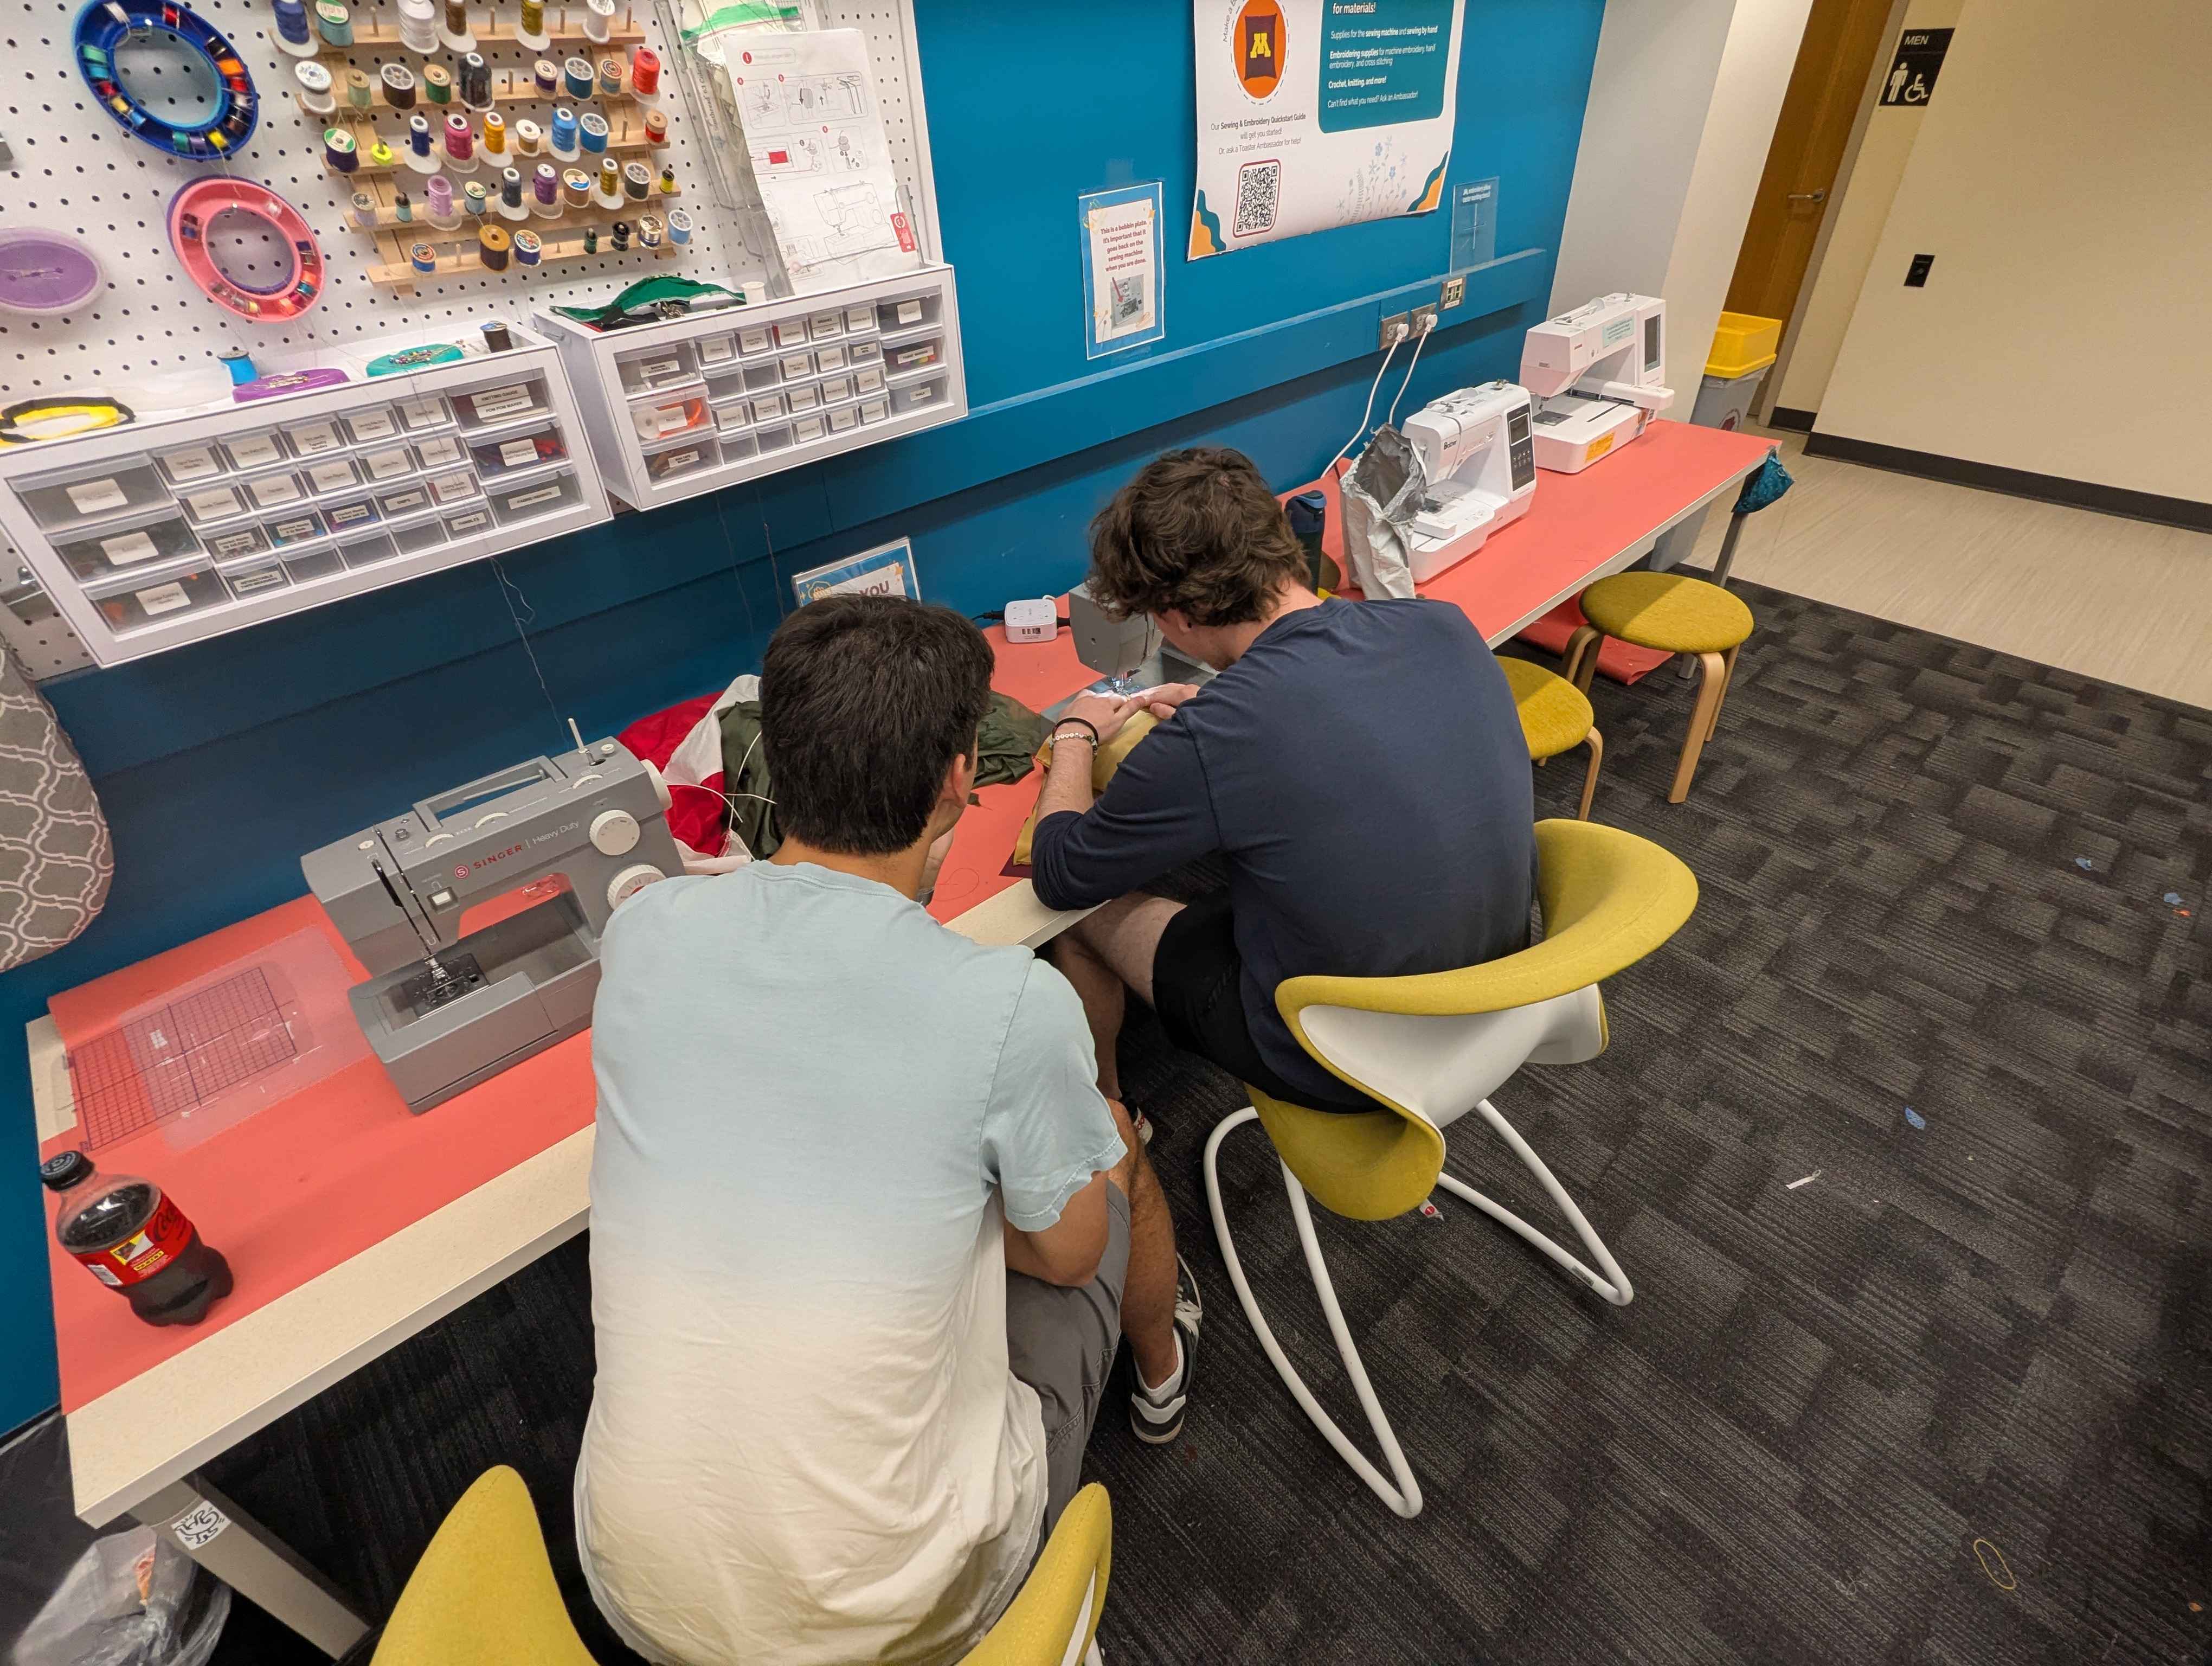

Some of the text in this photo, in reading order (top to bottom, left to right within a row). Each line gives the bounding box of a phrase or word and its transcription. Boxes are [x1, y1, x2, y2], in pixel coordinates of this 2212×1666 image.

[1333, 2, 1377, 14] for materials!
[1331, 31, 1350, 40] Supplies
[1366, 29, 1380, 38] sewing
[1381, 28, 1398, 36] machine
[1407, 27, 1421, 36] sewing
[1422, 26, 1427, 35] by
[1904, 35, 1929, 46] MEN
[1330, 49, 1360, 59] Embroidering
[1361, 48, 1379, 58] supplies
[1376, 57, 1393, 67] stitching
[1365, 77, 1374, 85] and
[1374, 76, 1387, 84] more!
[1358, 98, 1366, 106] you
[1221, 121, 1239, 130] Sewing
[1244, 117, 1270, 126] Embroidery
[1270, 114, 1294, 123] Quickstart
[1248, 131, 1256, 140] get
[1266, 127, 1282, 136] started!
[1226, 145, 1235, 153] ask
[1239, 143, 1256, 152] Toaster
[1257, 139, 1283, 149] Ambassador
[1118, 222, 1134, 230] bobbin
[1135, 220, 1147, 228] plate.
[1110, 232, 1132, 242] important
[1107, 246, 1117, 254] goes
[1108, 249, 1143, 262] sewing machine
[859, 580, 890, 596] YOU
[473, 844, 523, 869] SINGER
[532, 829, 558, 844] Heavy
[559, 821, 580, 833] Duty
